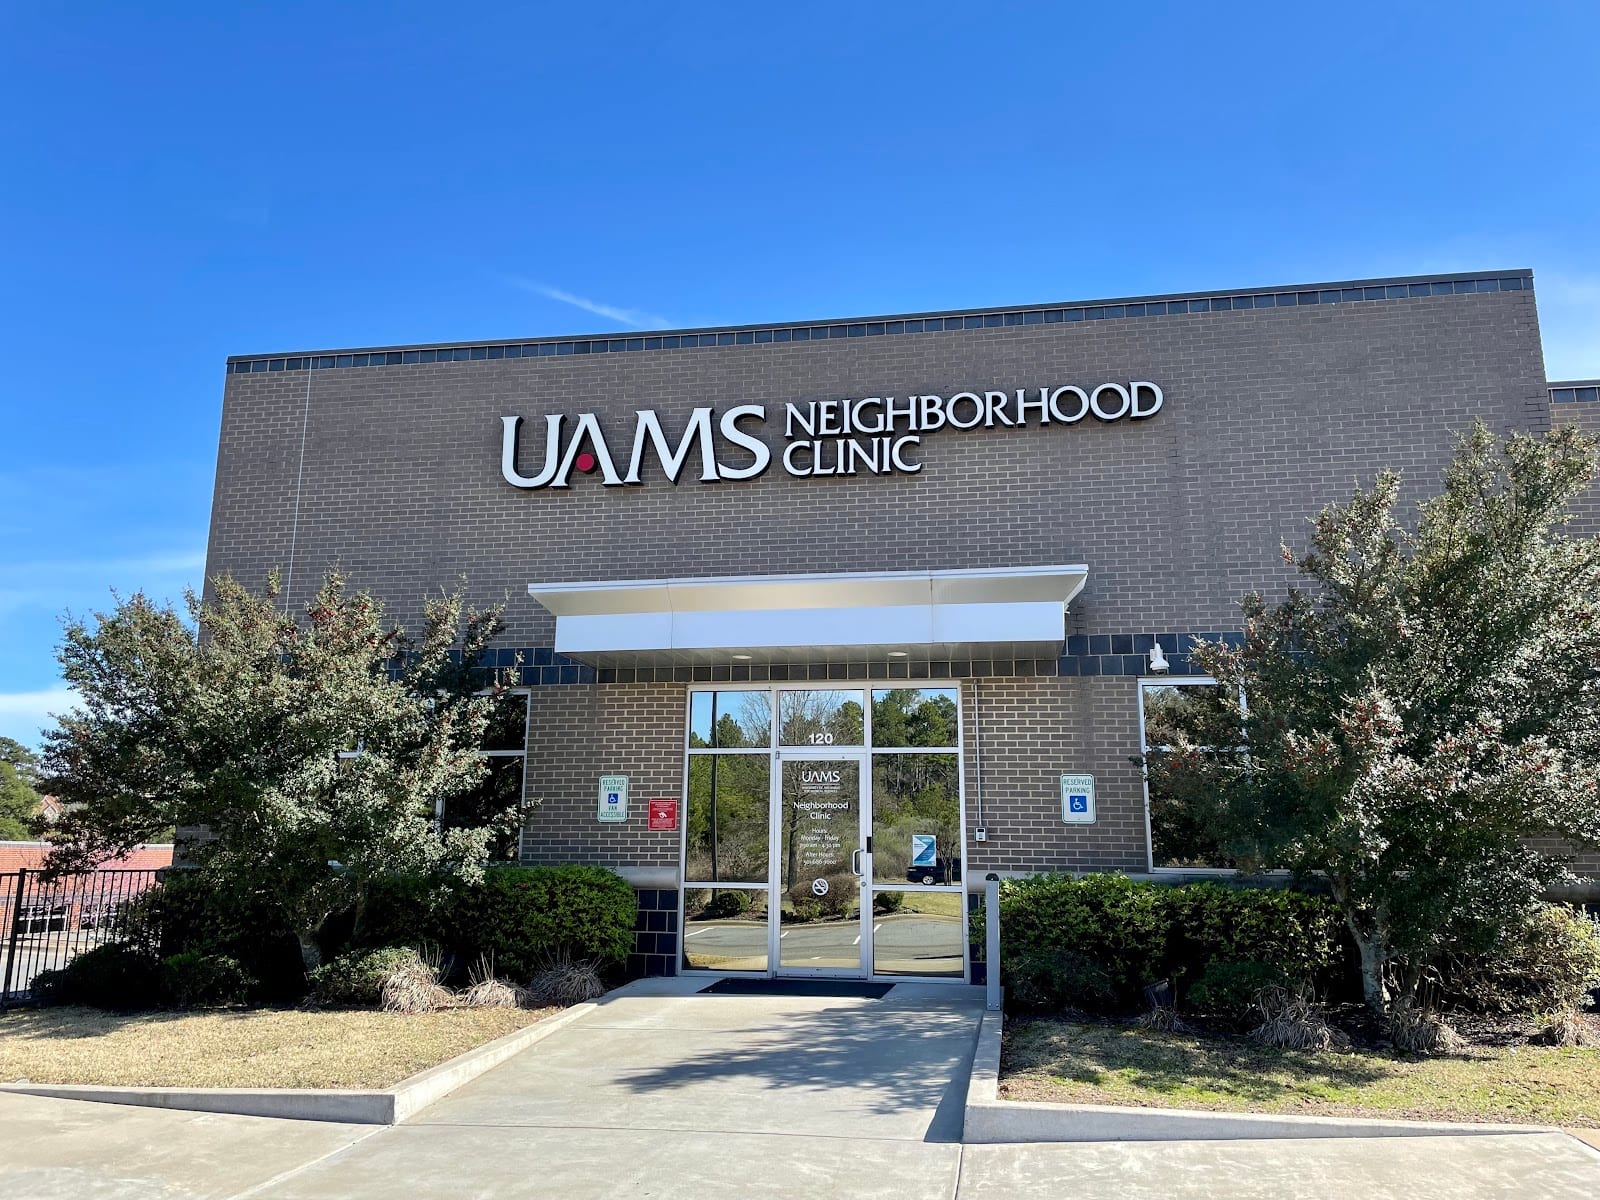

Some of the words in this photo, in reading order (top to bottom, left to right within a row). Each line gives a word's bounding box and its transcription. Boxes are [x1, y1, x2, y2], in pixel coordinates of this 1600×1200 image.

[784, 381, 1164, 439] NEIGHBORHOOD
[500, 404, 771, 488] UAMS
[783, 435, 922, 476] CLINIC
[808, 733, 833, 745] 120
[801, 770, 841, 783] UAMS
[1063, 778, 1092, 786] RESERVED
[1065, 786, 1090, 794] PARKING
[793, 801, 849, 811] Neighborhood
[810, 812, 831, 820] Clinic
